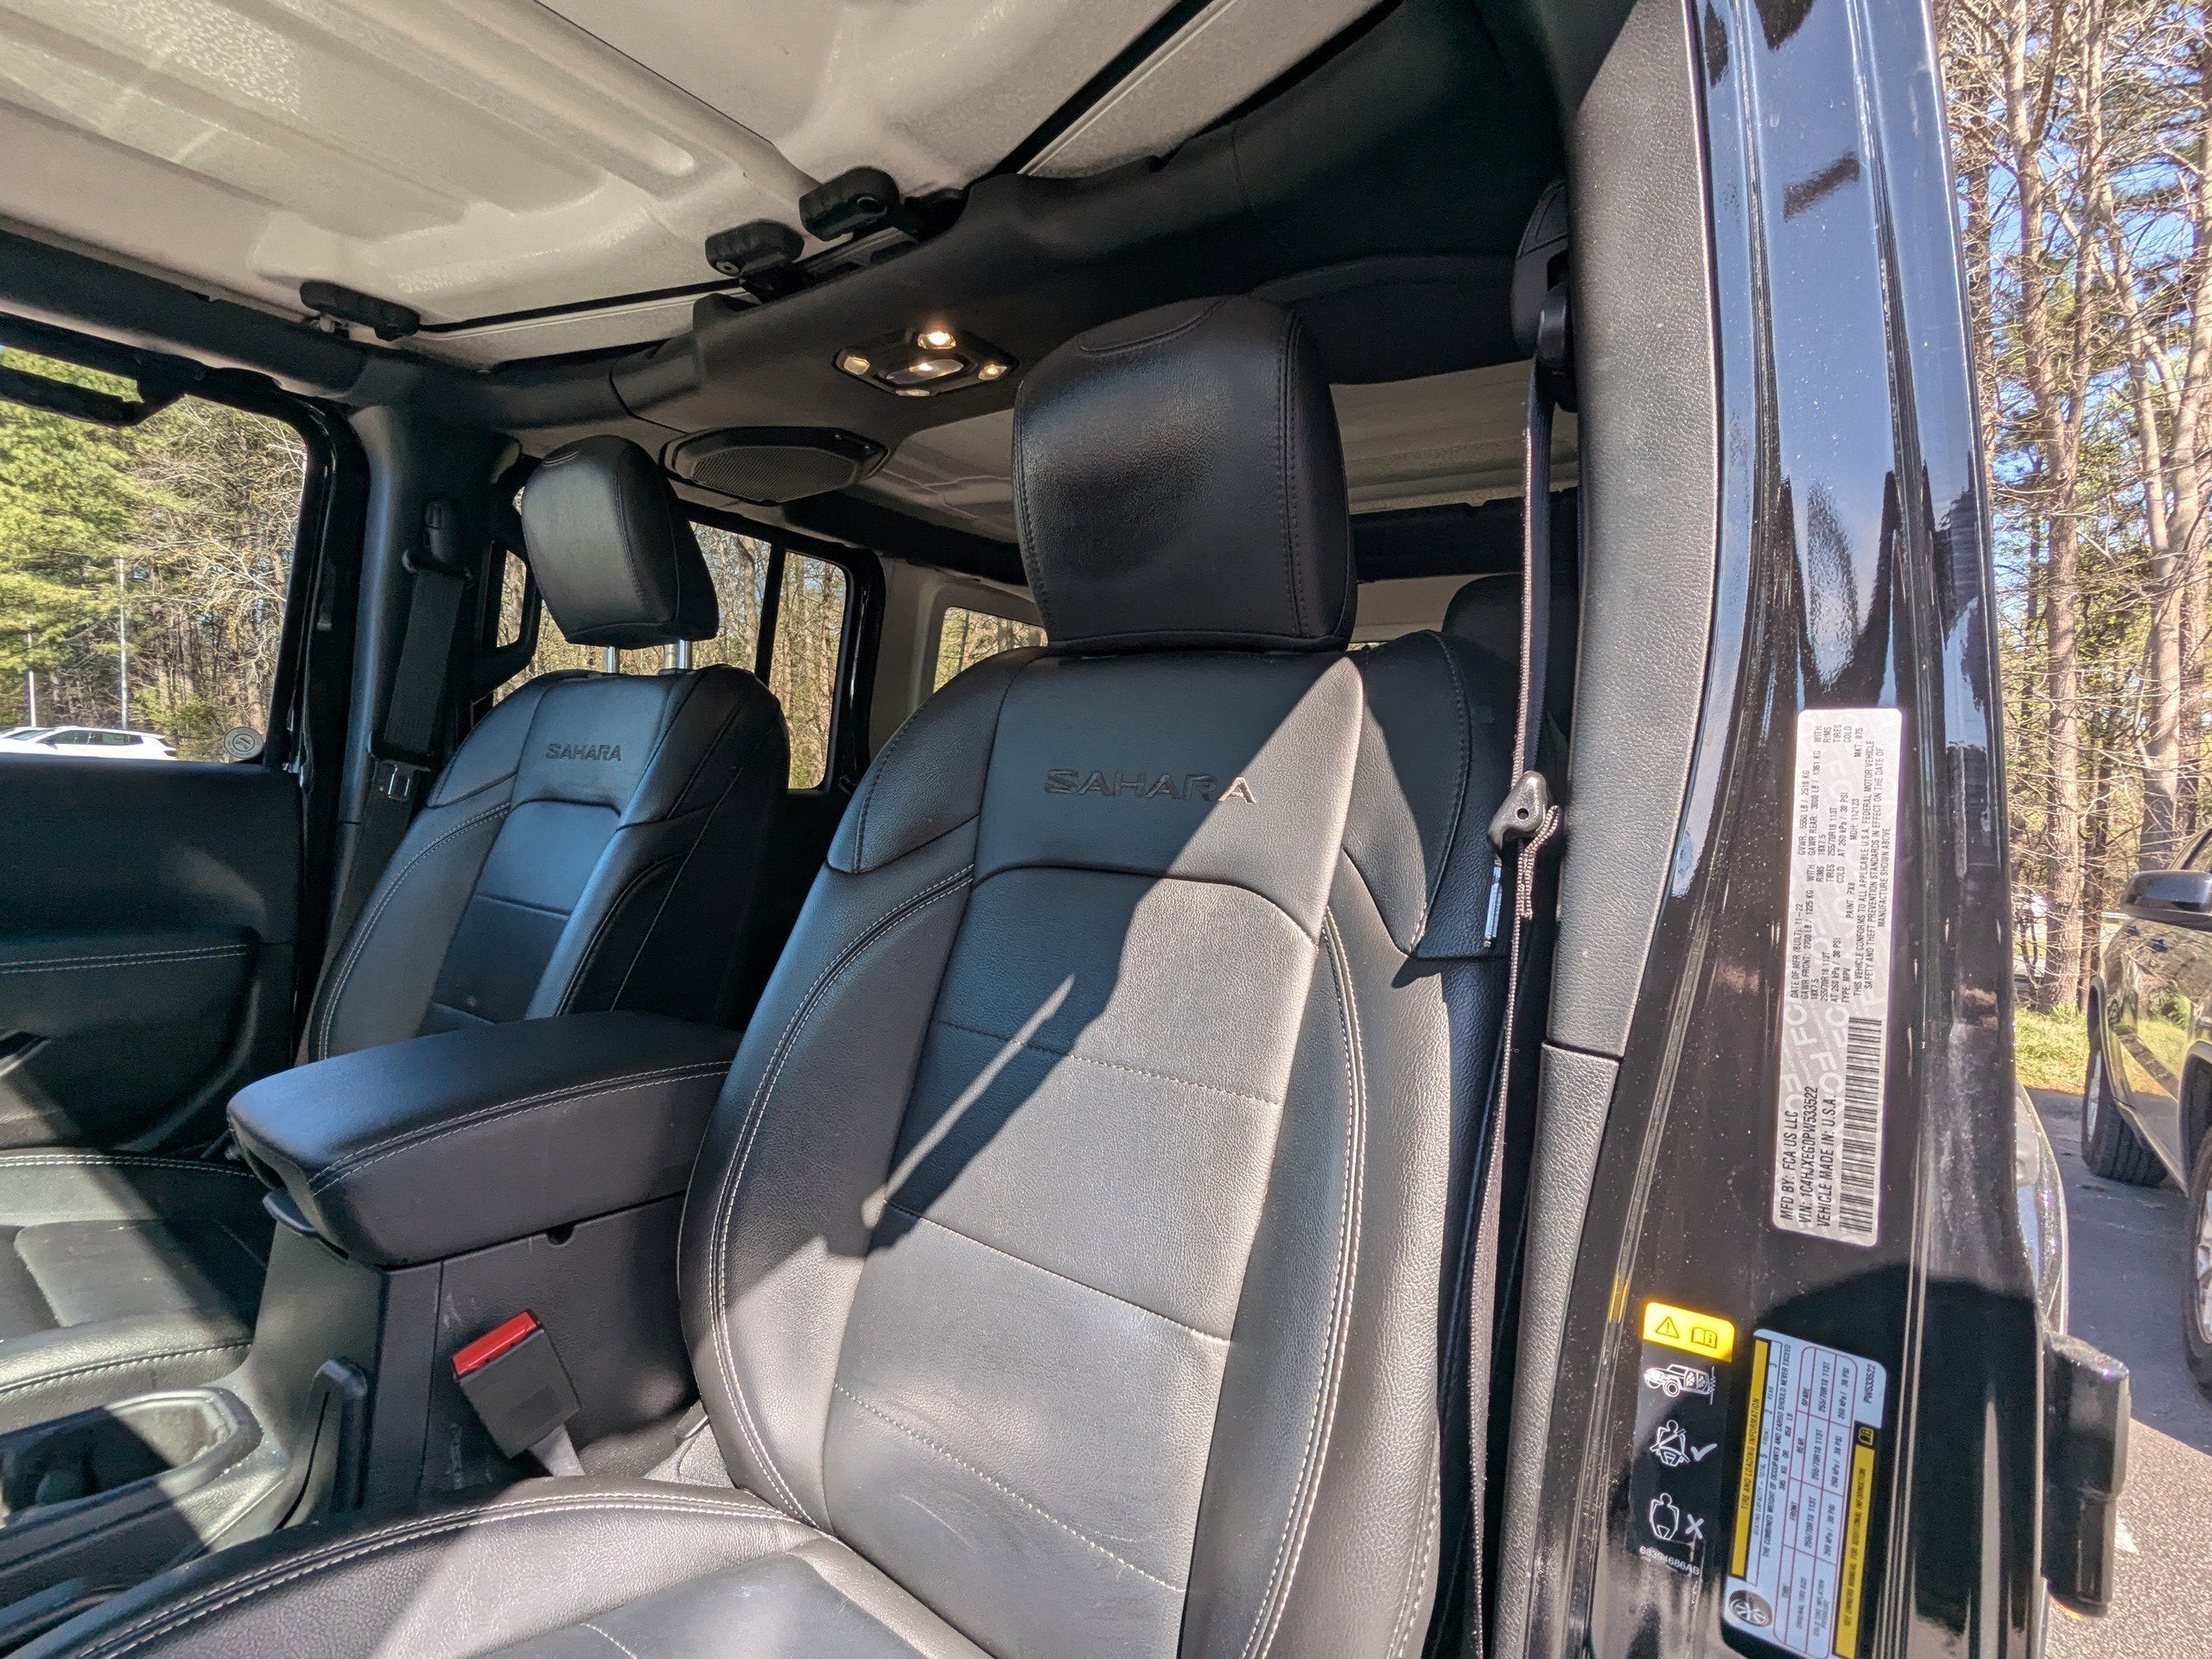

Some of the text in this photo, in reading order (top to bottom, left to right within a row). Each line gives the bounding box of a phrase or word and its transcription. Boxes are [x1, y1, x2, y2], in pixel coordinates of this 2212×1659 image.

[1833, 724, 1841, 742] TIRES
[1843, 726, 1852, 742] COLD
[546, 743, 621, 760] SAHARA
[1865, 740, 1873, 766] VEHICLE
[1802, 770, 1808, 779] KG
[1874, 759, 1883, 774] DATE
[1044, 768, 1256, 804] SAHARA
[1863, 769, 1872, 791] MOTOR
[1808, 836, 1816, 855] GAWR
[1813, 750, 1820, 759] KG
[1862, 793, 1871, 823] FEDERAL
[1873, 792, 1881, 802] ON
[1872, 804, 1881, 828] EFFECT
[1859, 849, 1868, 887] APPLICABLE
[1870, 839, 1879, 879] STANDARDS
[1880, 851, 1889, 875] SHOWN
[1826, 863, 1834, 882] TIRES
[1858, 889, 1866, 901] ALL
[1867, 881, 1877, 922] PREVENTION
[1878, 878, 1888, 927] MANUFACTURE
[1858, 903, 1866, 912] TO
[1801, 979, 1809, 999] GAWR
[1806, 889, 1814, 898] KG
[1856, 914, 1865, 950] CONFORMS
[1866, 925, 1875, 944] THEFT
[1854, 952, 1863, 979] VEHICLE
[1866, 947, 1874, 961] AND
[1791, 970, 1799, 979] OF
[1865, 963, 1873, 988] SAFETY
[1790, 981, 1799, 998] DATE
[1830, 994, 1838, 1002] AT
[1853, 981, 1862, 996] THIS
[1780, 1109, 1798, 1220] MFD BY: FCA US LLC
[1817, 1093, 1835, 1227] VEHICLE MADE IN: U.S.A.
[1798, 1201, 1812, 1224] VIN:
[1748, 1397, 1759, 1445] INFORMATION
[1745, 1446, 1754, 1476] LOADING
[1764, 1514, 1772, 1544] COMBINED
